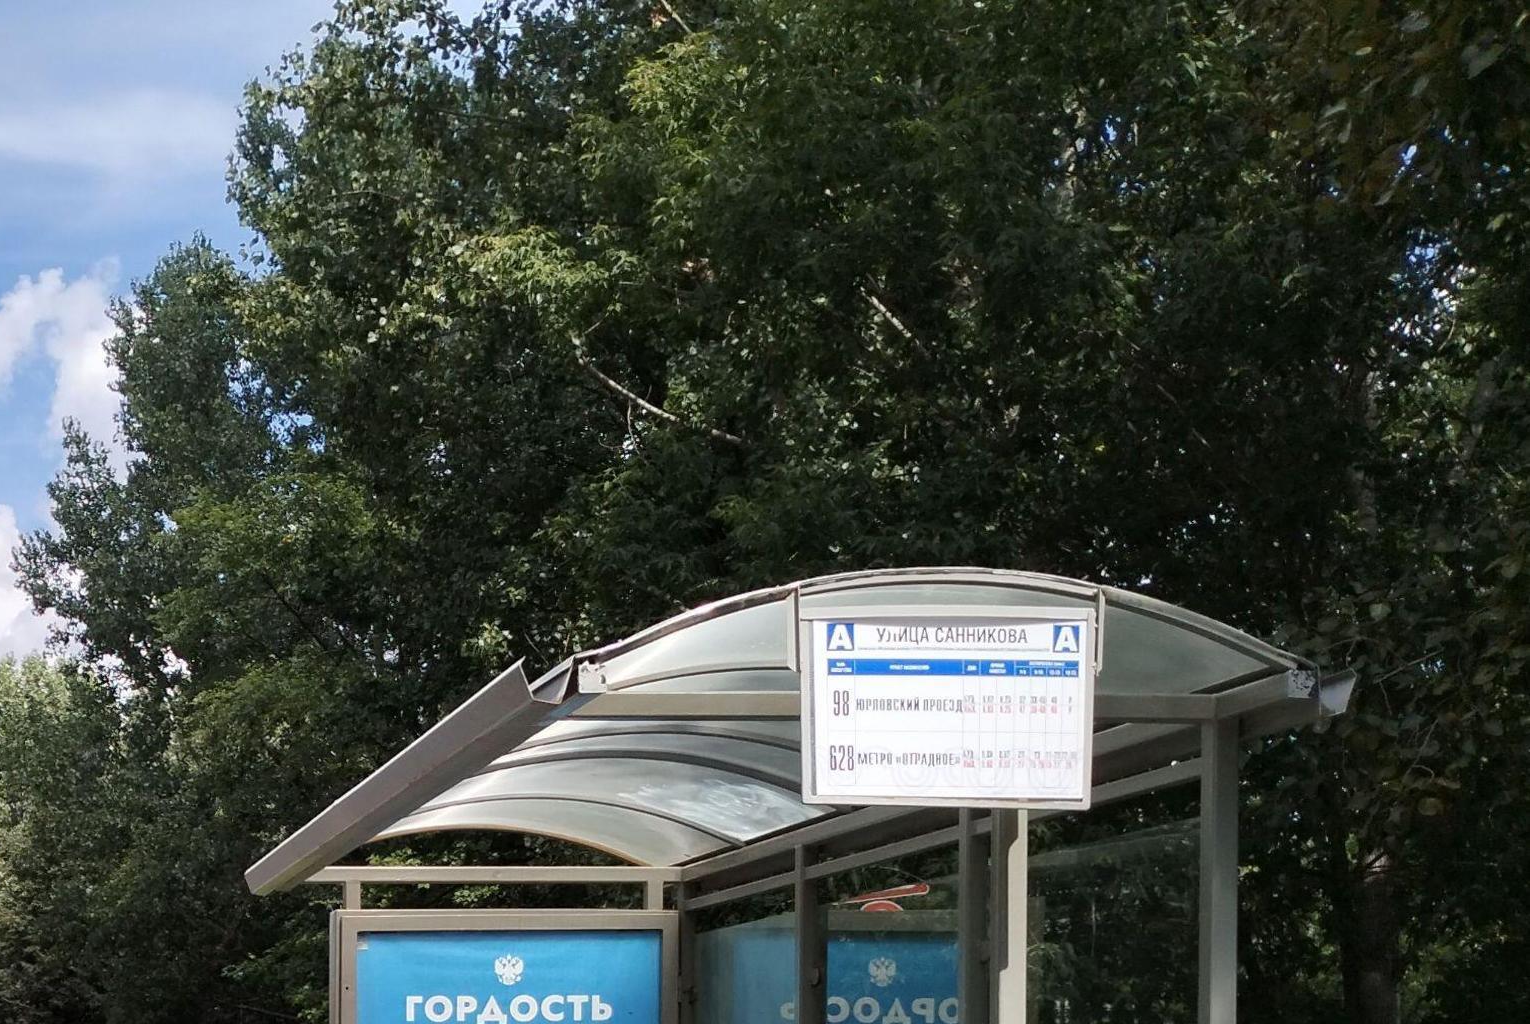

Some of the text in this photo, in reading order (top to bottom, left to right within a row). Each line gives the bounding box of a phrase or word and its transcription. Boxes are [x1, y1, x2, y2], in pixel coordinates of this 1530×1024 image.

[876, 627, 1028, 645] УЛИЦА САННИКОВА
[833, 690, 850, 716] 98
[856, 697, 920, 711] ЮРЛОВСКИЙ
[923, 699, 963, 713] ПРОЕЗД
[830, 745, 854, 771] 628
[858, 752, 892, 766] МЕТРО
[405, 994, 612, 1024] ГОРДОСТЬ
